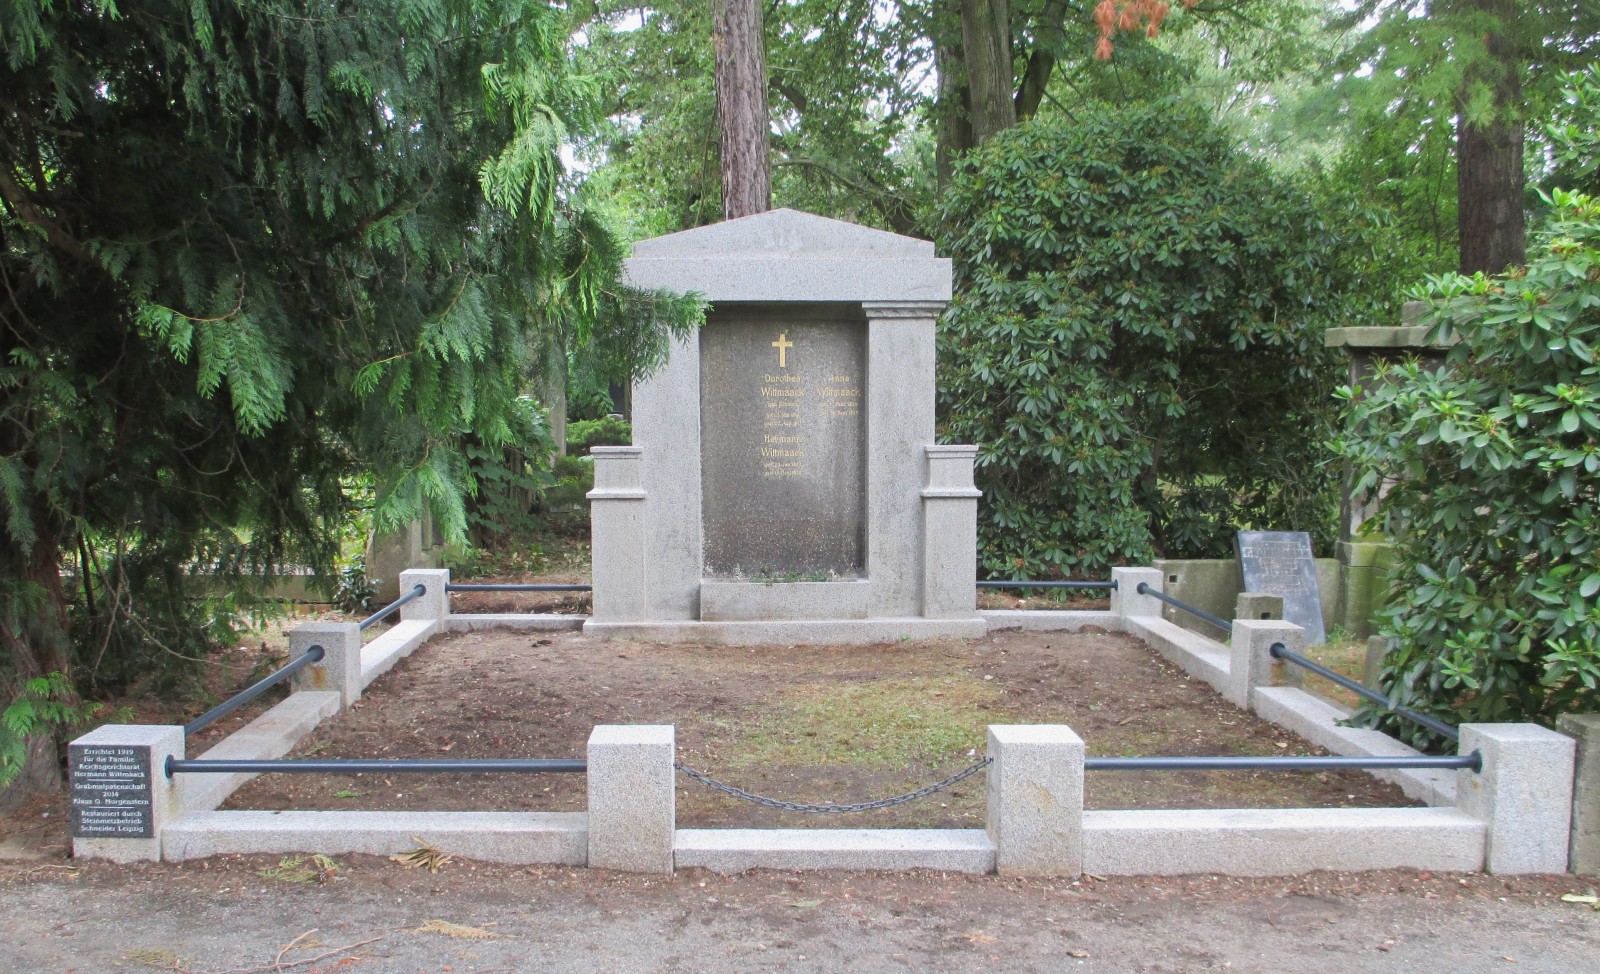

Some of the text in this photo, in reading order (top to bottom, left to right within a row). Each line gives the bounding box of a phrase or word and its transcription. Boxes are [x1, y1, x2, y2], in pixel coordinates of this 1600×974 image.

[764, 373, 801, 383] Dorothea
[828, 374, 850, 383] Anna
[760, 386, 805, 397] Wittmaack
[764, 434, 801, 443] Hermann
[760, 447, 805, 457] Wittmaack
[79, 763, 140, 771] Reichsgerichtsrat
[75, 782, 146, 790] Grabmalpatenschaft
[105, 798, 149, 806] Morgenstern
[118, 825, 144, 833] Leipzig
